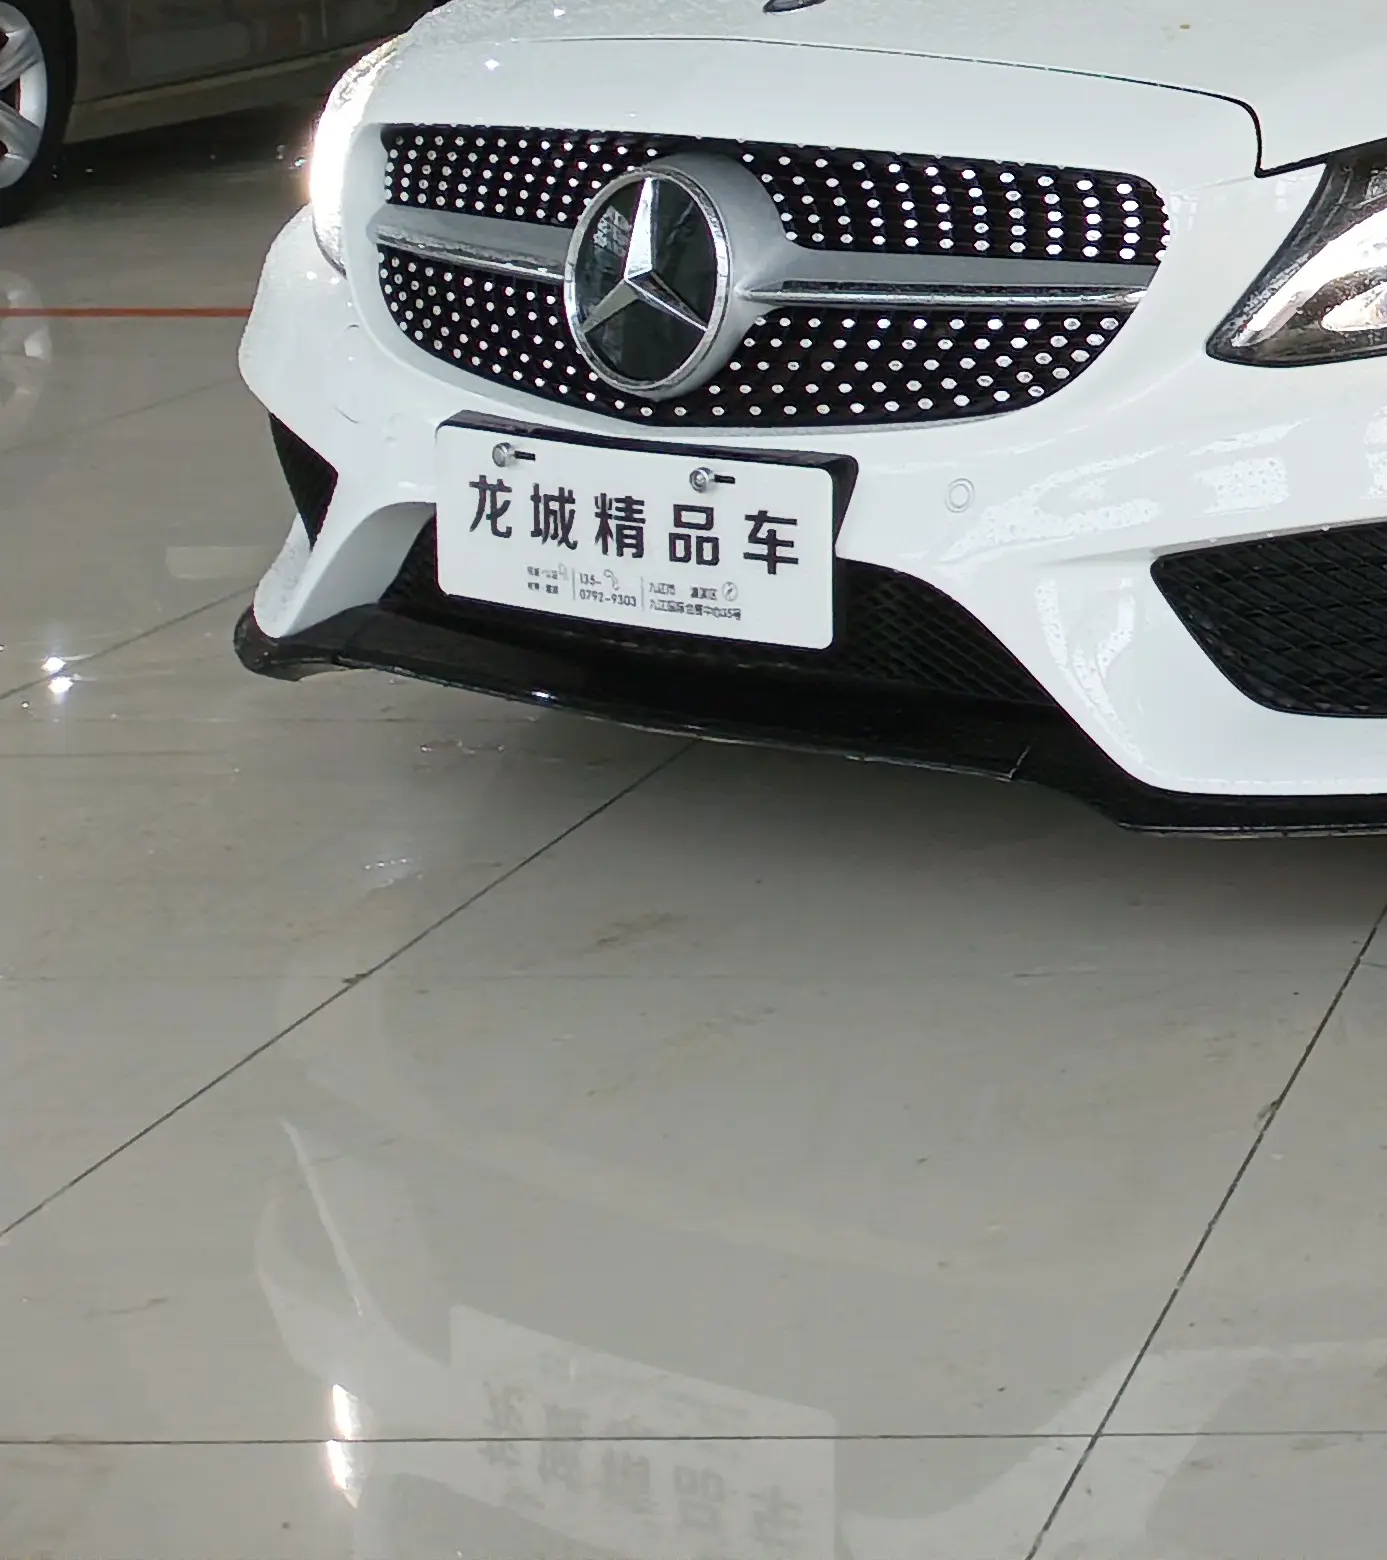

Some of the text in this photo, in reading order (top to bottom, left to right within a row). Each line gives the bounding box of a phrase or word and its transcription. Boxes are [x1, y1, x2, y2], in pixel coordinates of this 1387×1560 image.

[469, 473, 799, 576] 龙城精品车
